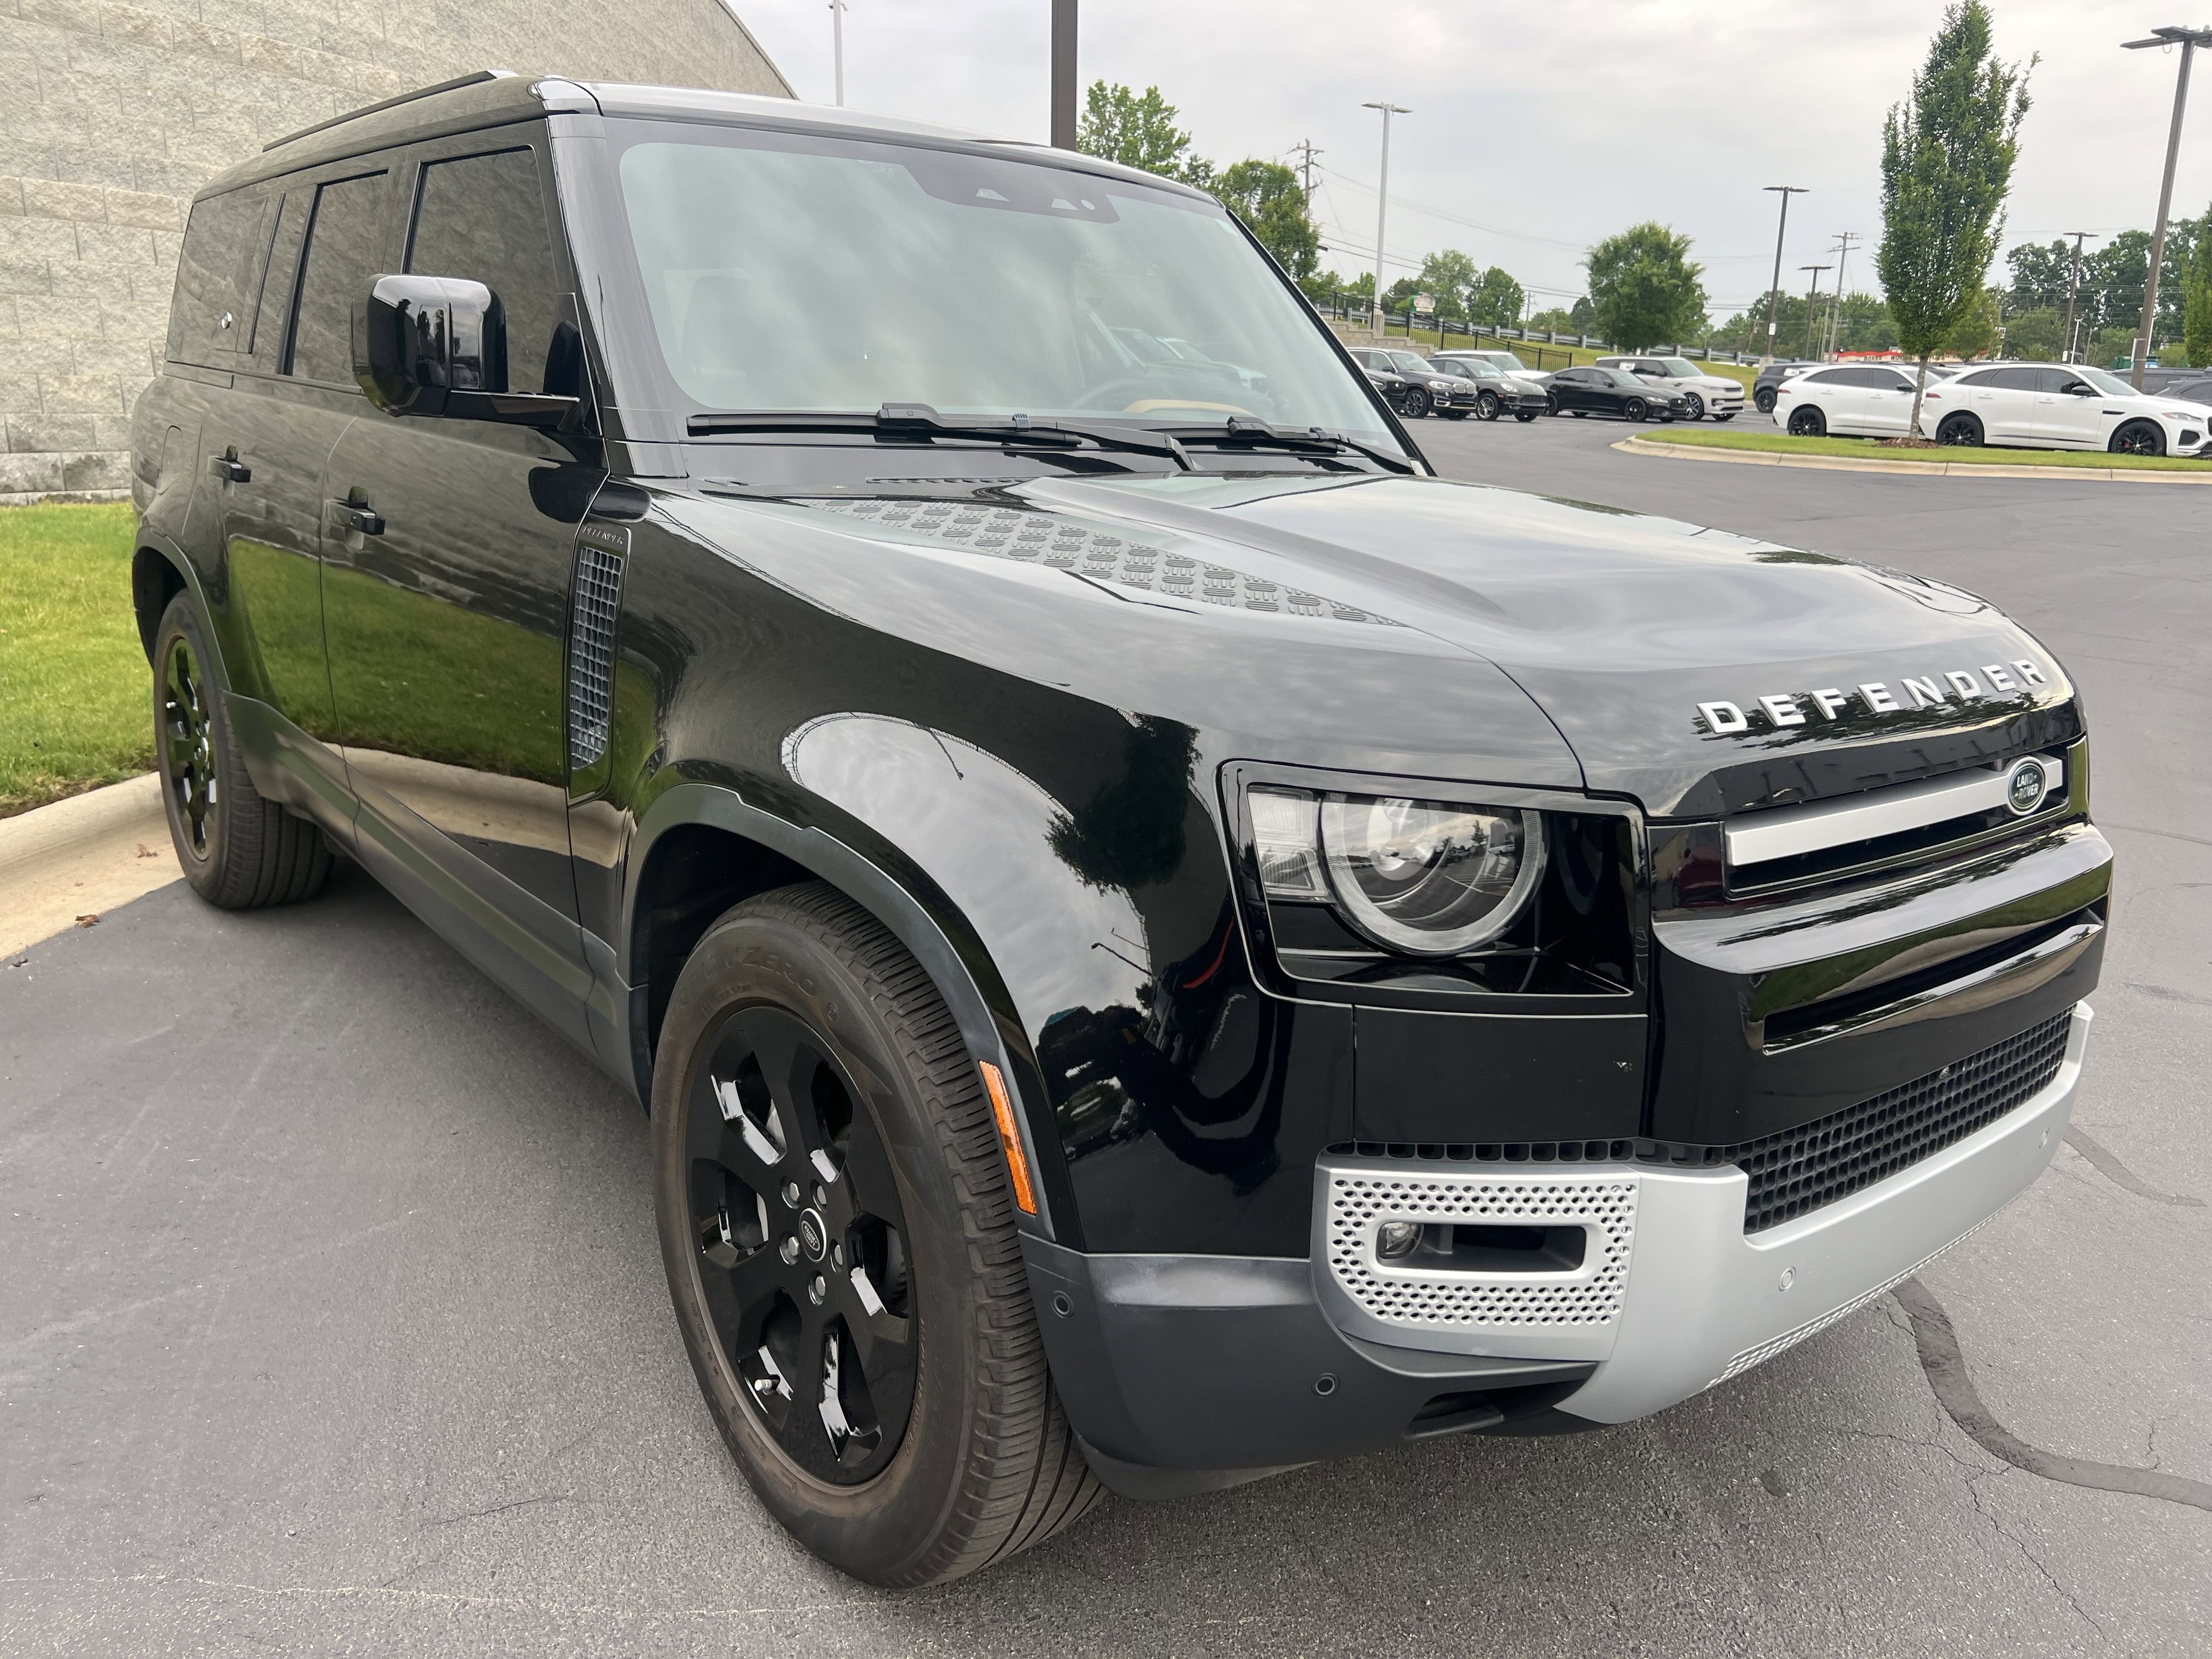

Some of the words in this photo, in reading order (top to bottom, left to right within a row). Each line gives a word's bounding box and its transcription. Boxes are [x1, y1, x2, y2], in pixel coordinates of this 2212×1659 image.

[1696, 658, 2046, 734] DEFENDER
[2016, 772, 2034, 788] LAND
[2018, 783, 2039, 800] ROVER
